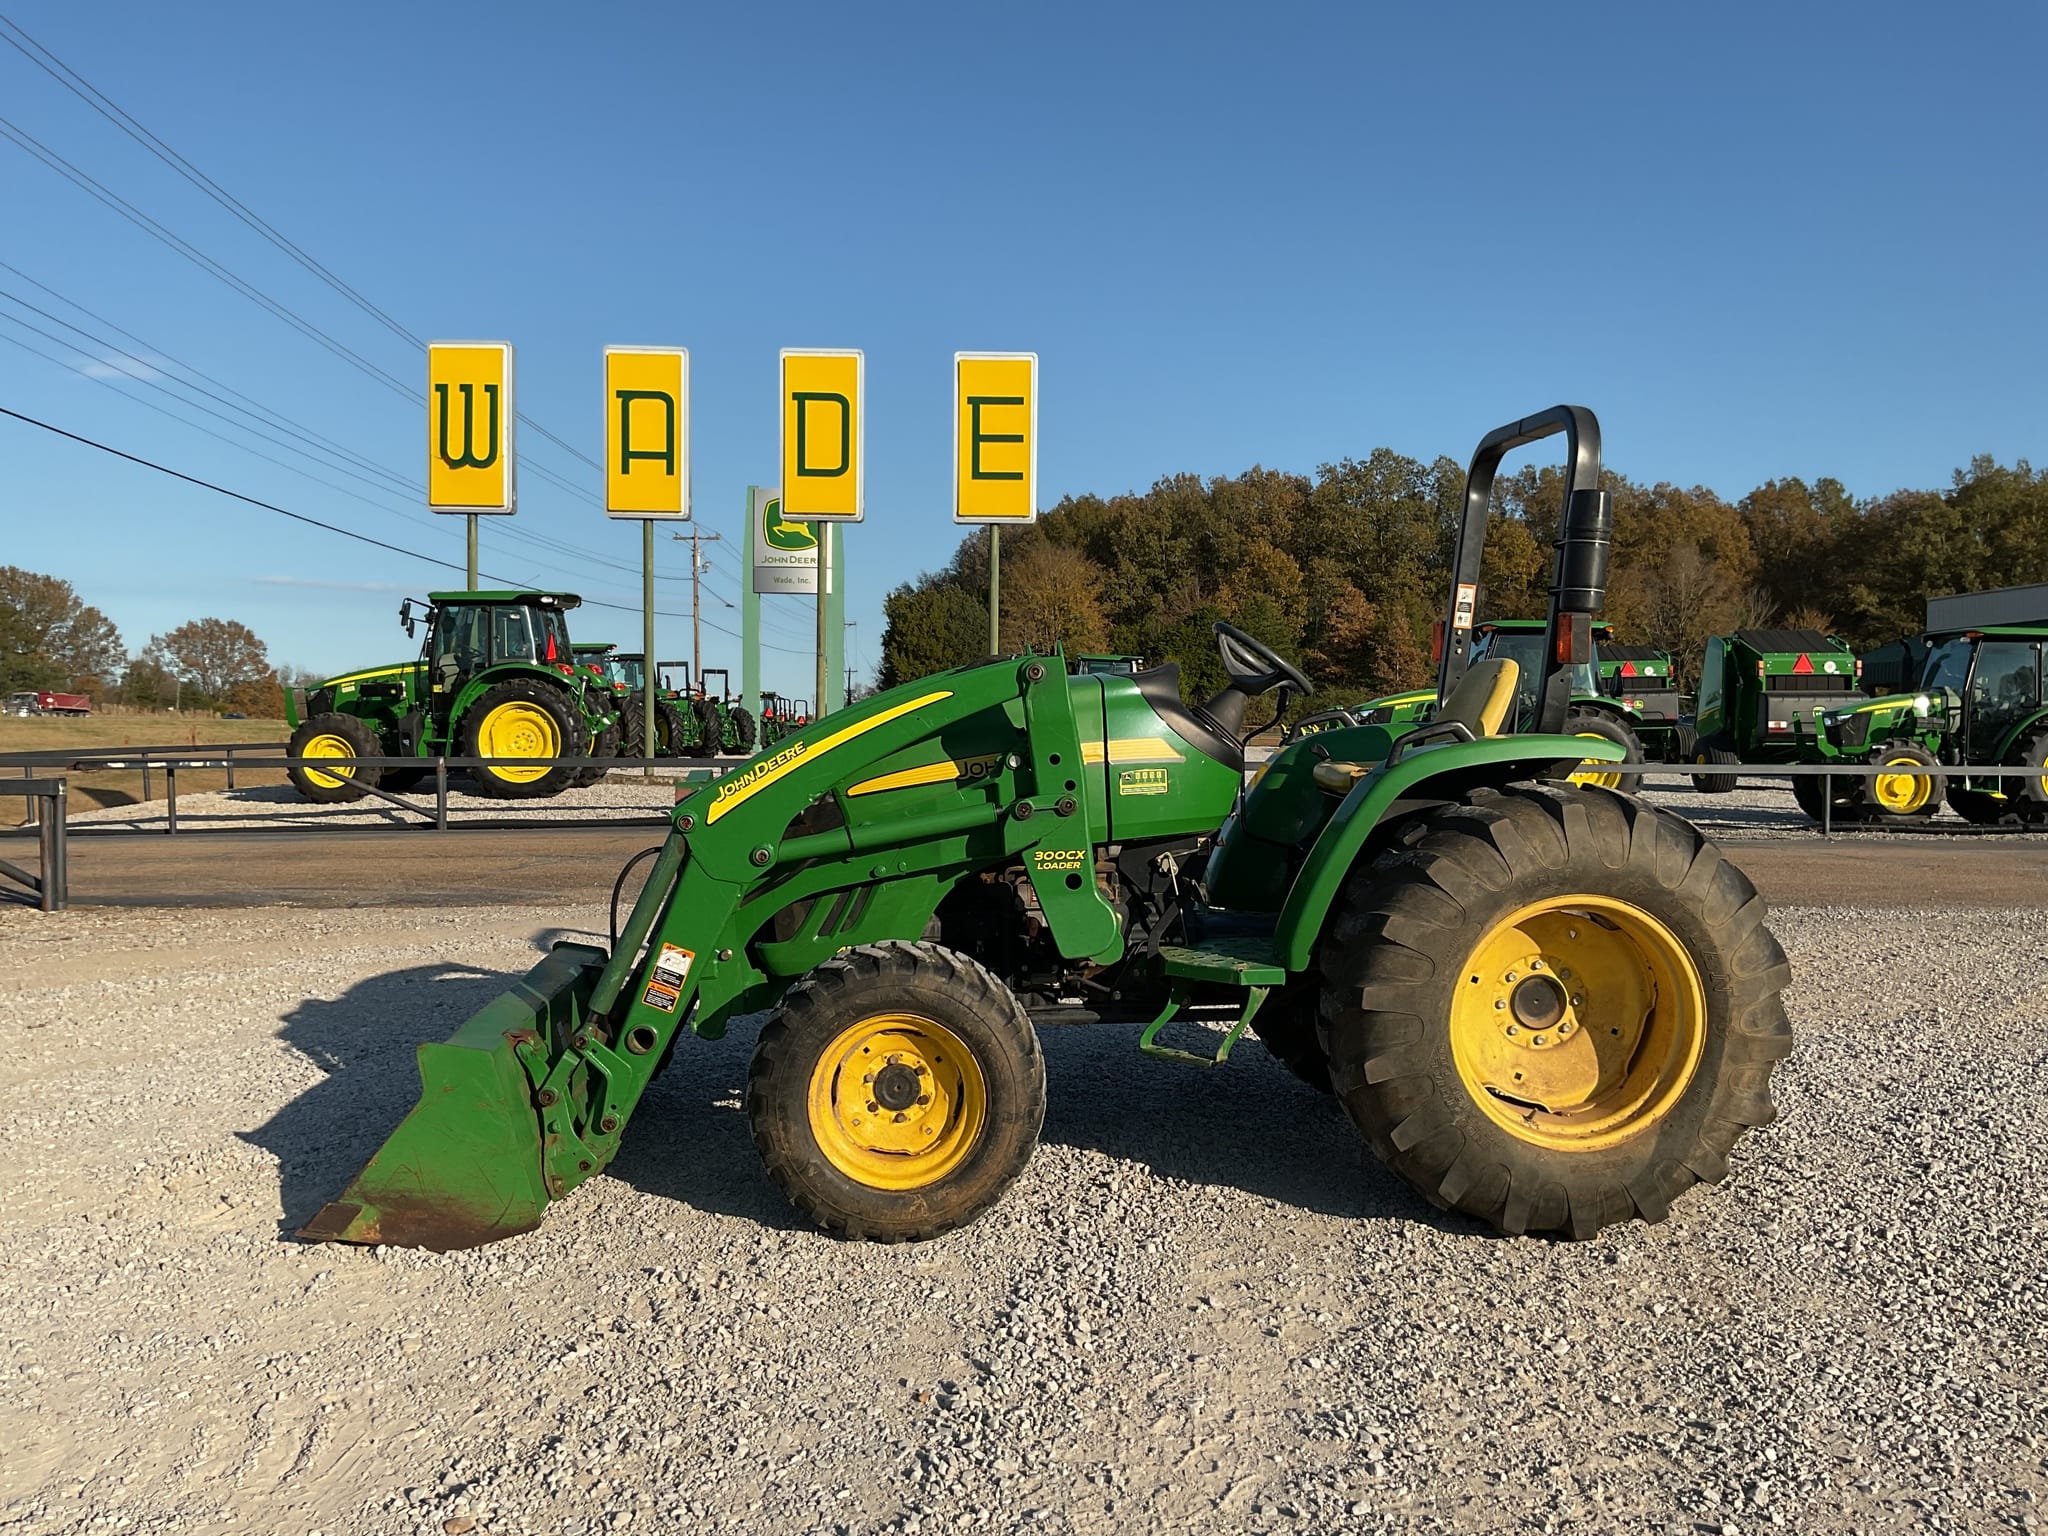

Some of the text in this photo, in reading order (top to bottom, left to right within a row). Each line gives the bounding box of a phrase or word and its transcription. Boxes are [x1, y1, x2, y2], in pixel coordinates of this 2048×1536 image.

[761, 555, 817, 565] JOHN DEER
[773, 576, 812, 585] Wade, Inc.
[716, 740, 806, 803] JOHN DEERE
[1034, 850, 1086, 861] 300CX
[1037, 861, 1081, 870] LOADER
